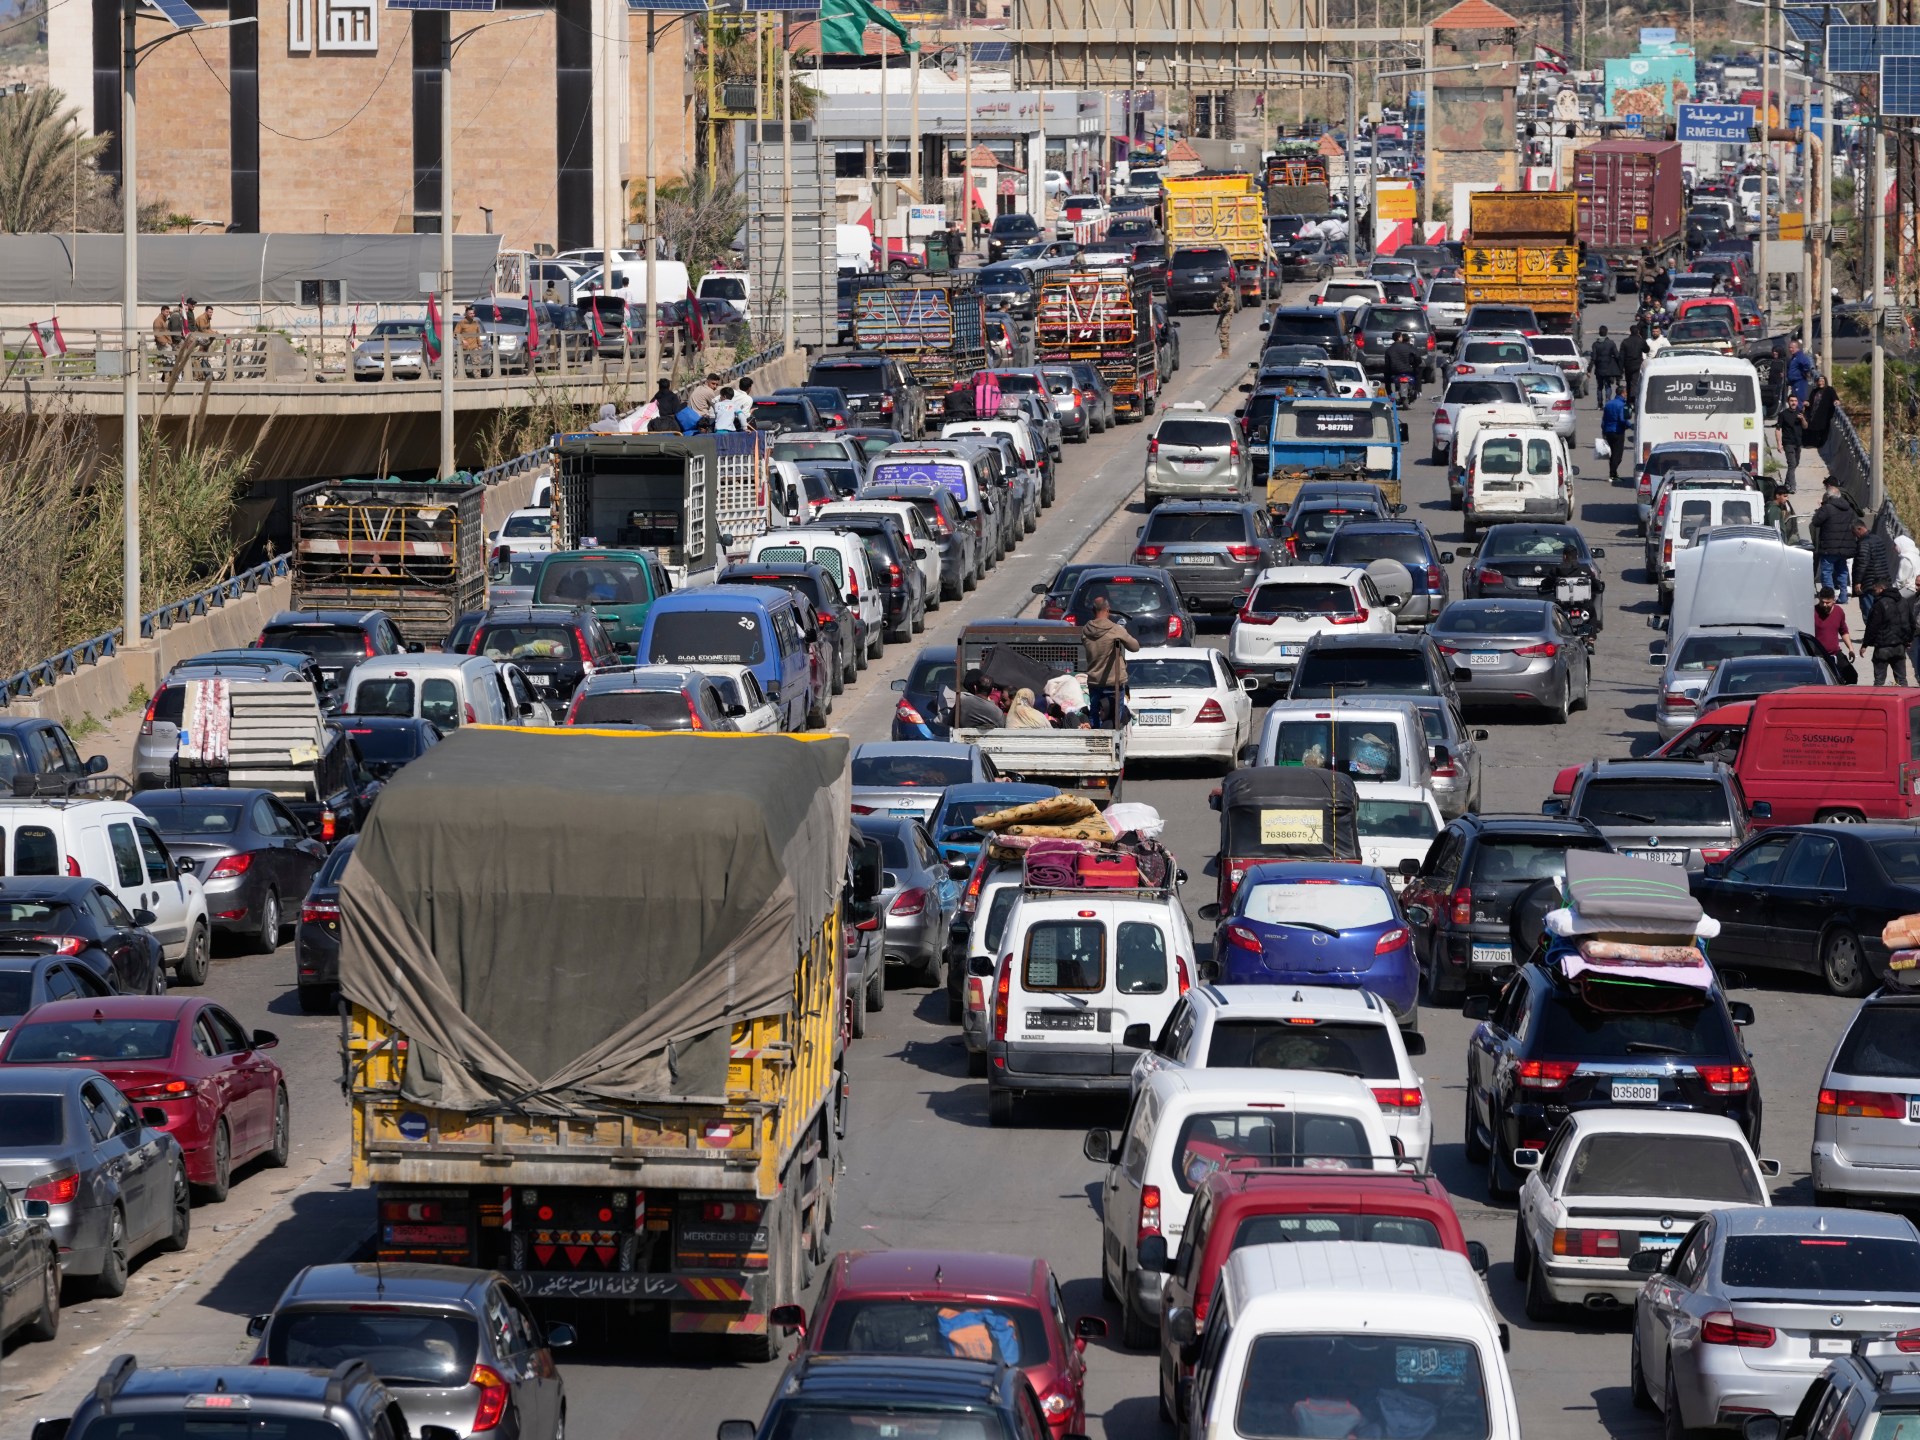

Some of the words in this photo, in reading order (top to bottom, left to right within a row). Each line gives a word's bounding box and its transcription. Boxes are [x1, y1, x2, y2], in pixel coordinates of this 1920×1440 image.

[1686, 108, 1744, 124] الرميلة
[1686, 127, 1744, 138] RMEILEH
[1664, 381, 1693, 393] مراد
[1674, 431, 1728, 439] NISSAN
[738, 616, 755, 630] 29
[1265, 831, 1308, 839] 76386675
[1473, 950, 1511, 961] S177061
